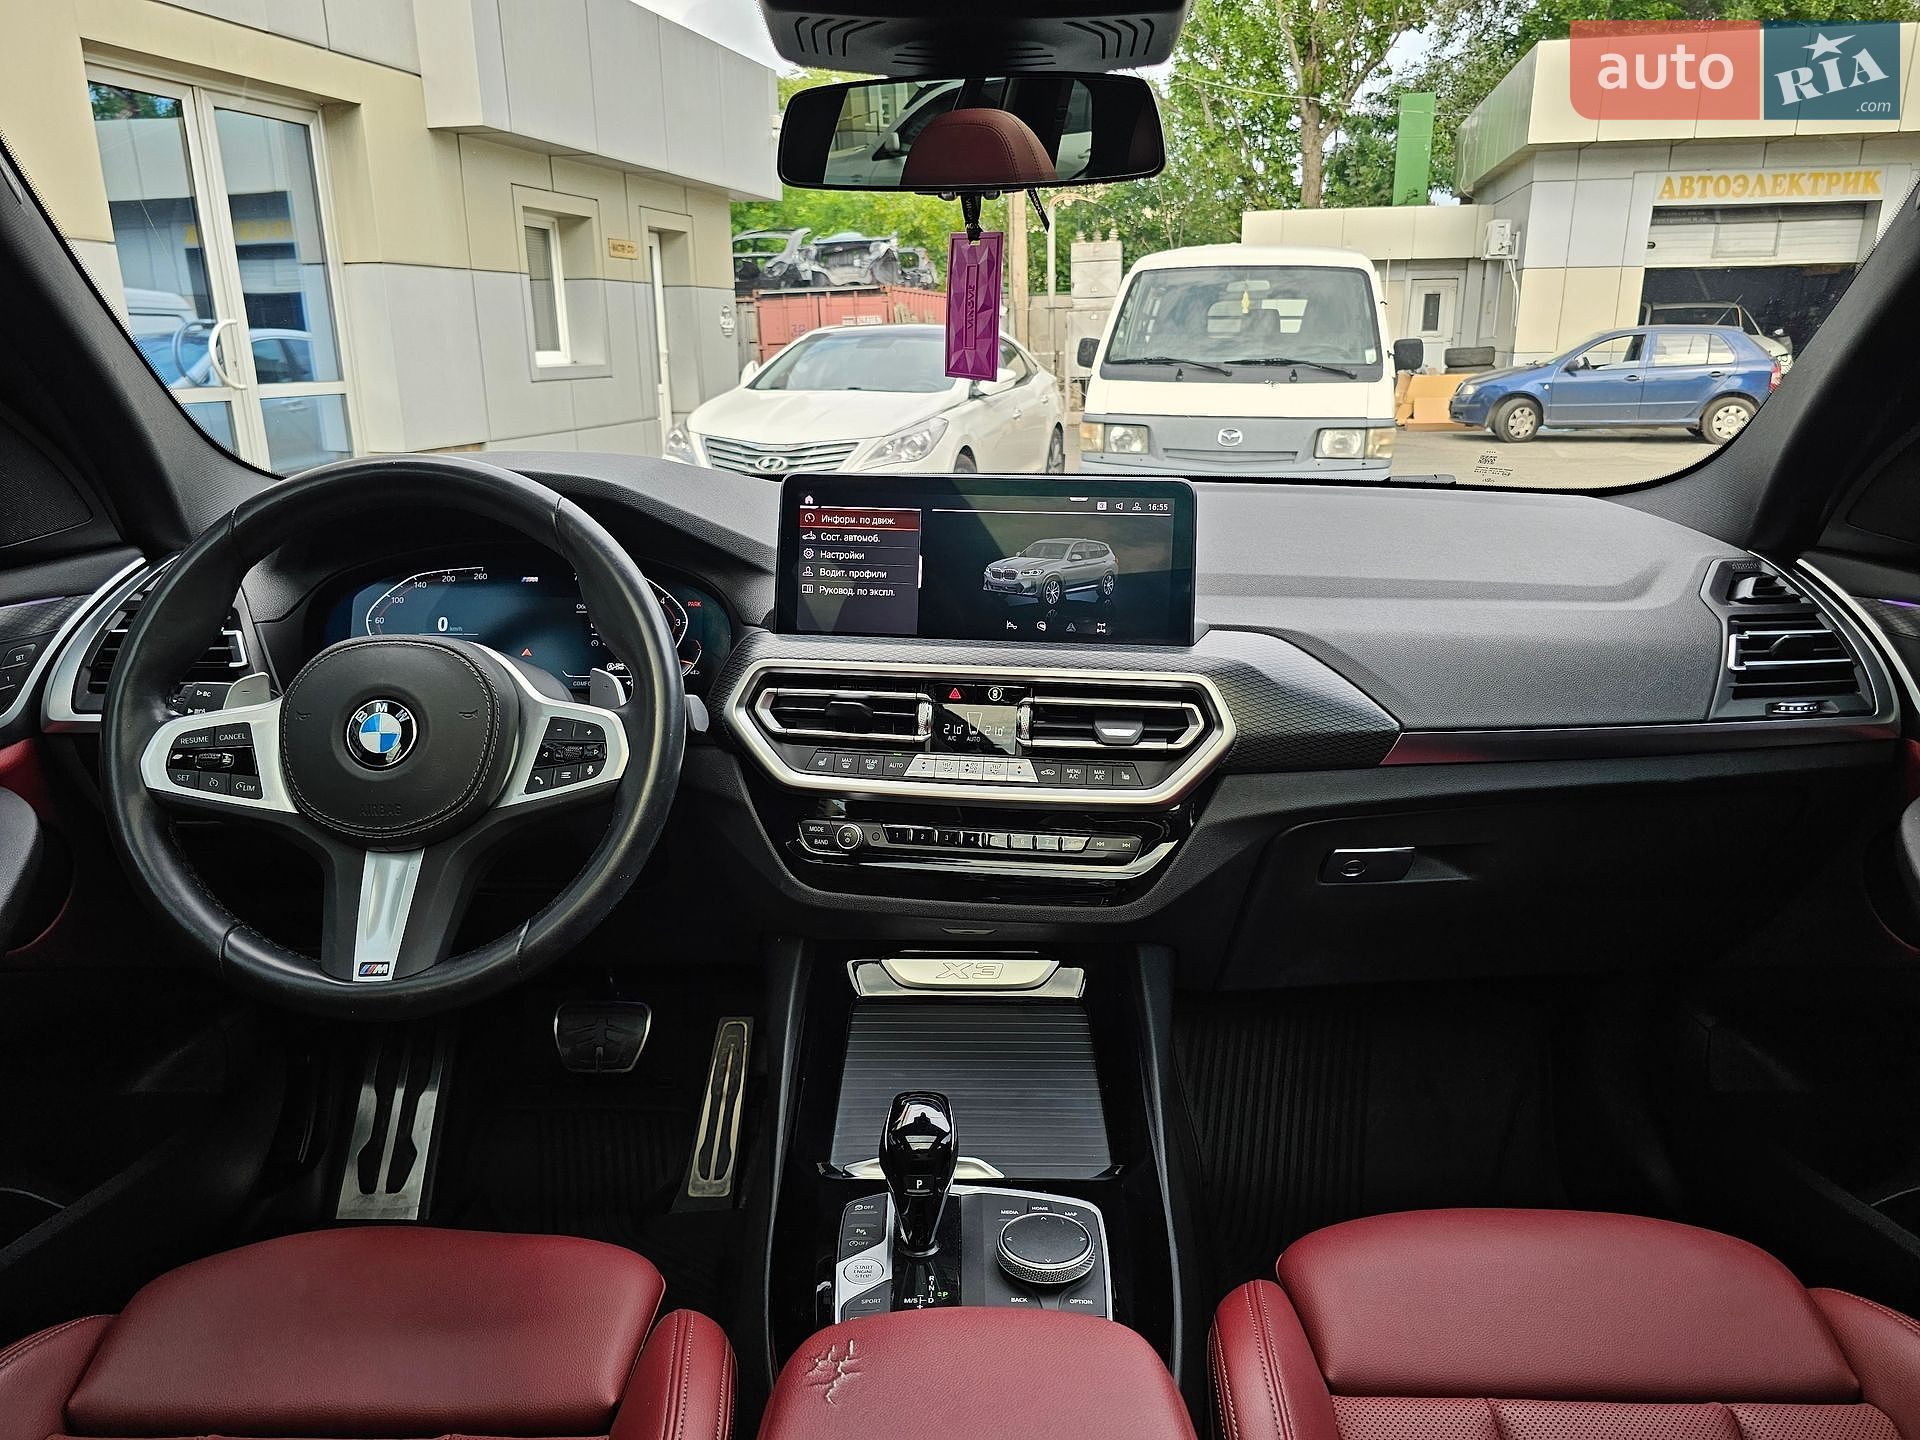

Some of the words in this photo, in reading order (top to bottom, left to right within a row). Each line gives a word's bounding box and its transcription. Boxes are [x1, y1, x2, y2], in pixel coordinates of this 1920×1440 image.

[1658, 171, 1882, 199] АВТОЭЛЕКТРИК
[1148, 503, 1168, 511] 16:55
[821, 514, 858, 525] Информ.
[820, 533, 842, 541] Сост.
[843, 534, 881, 543] автомоб.
[820, 550, 865, 561] Настройки
[819, 568, 848, 578] Водит.
[848, 570, 887, 579] профили
[441, 575, 456, 583] 200
[413, 581, 427, 589] 140
[819, 586, 855, 597] Руковод.
[660, 597, 665, 605] 4
[437, 617, 449, 632] 0
[15, 654, 25, 662] SET
[355, 703, 410, 723] BMW
[180, 736, 209, 745] RESUME
[219, 733, 246, 741] CANCEL
[935, 962, 1004, 979] X3
[916, 1179, 923, 1189] P
